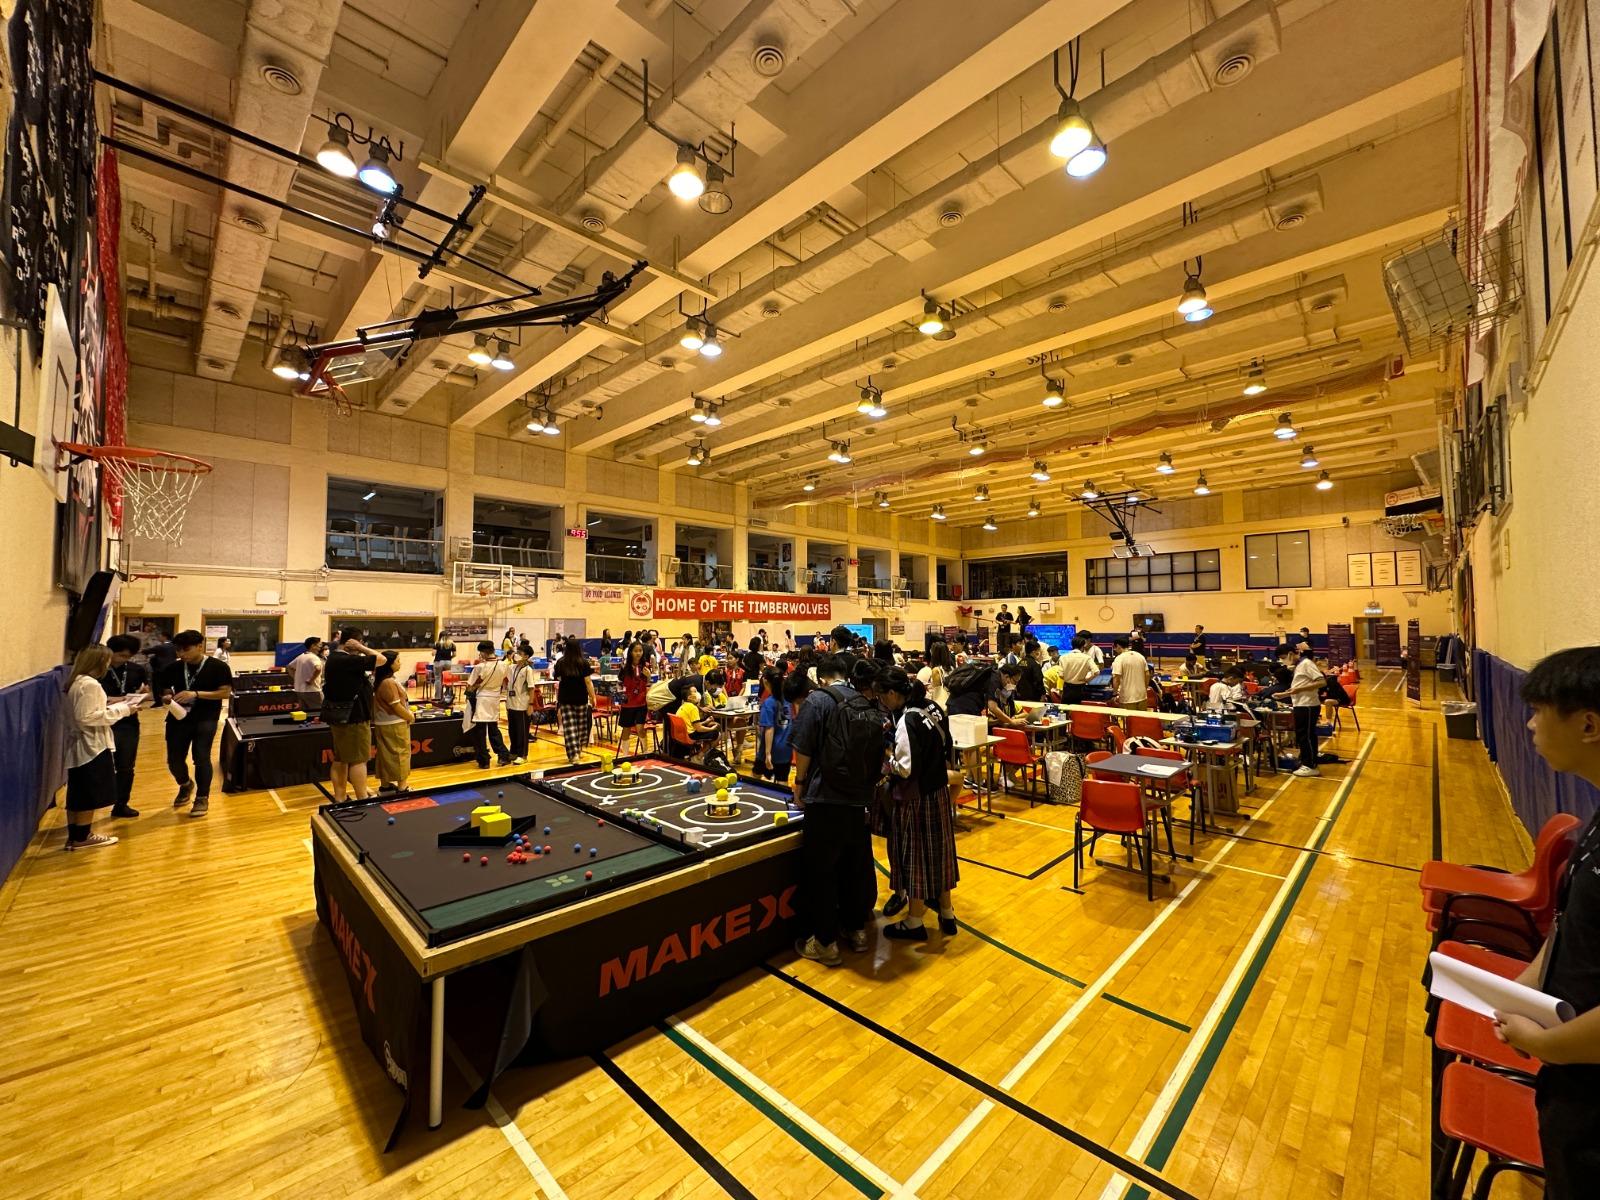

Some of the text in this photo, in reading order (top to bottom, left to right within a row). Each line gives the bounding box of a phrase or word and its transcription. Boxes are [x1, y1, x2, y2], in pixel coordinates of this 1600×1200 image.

[655, 598, 696, 612] HOME
[700, 599, 718, 613] OF
[721, 600, 744, 613] THE
[748, 601, 830, 614] TIMBERWOLVES
